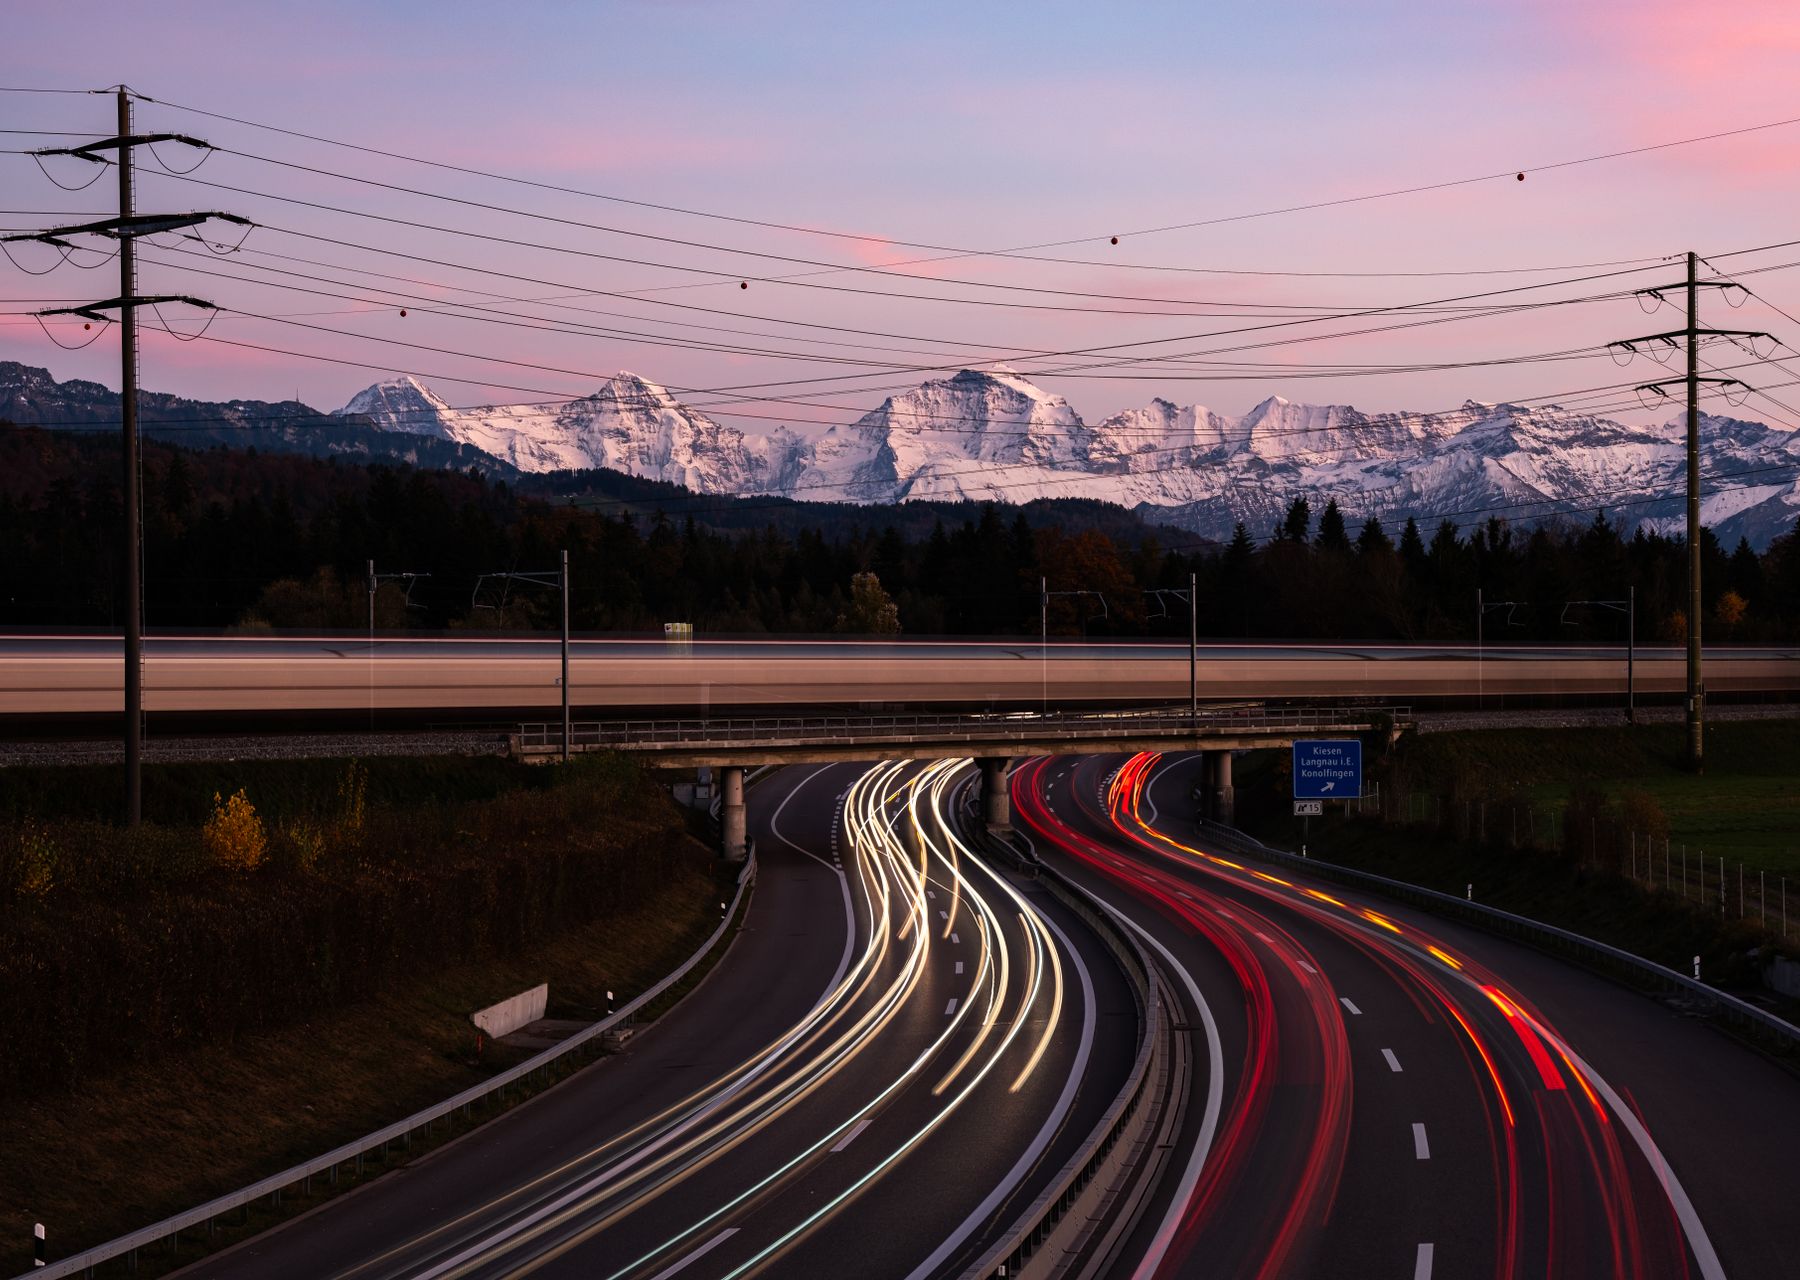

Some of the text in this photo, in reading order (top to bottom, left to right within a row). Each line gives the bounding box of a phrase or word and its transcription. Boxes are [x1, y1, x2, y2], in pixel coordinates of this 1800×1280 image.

[1313, 747, 1342, 755] Kiesen
[1301, 757, 1354, 768] Langnau i.E.
[1301, 769, 1354, 779] Konolfingen
[1309, 804, 1320, 812] 15
